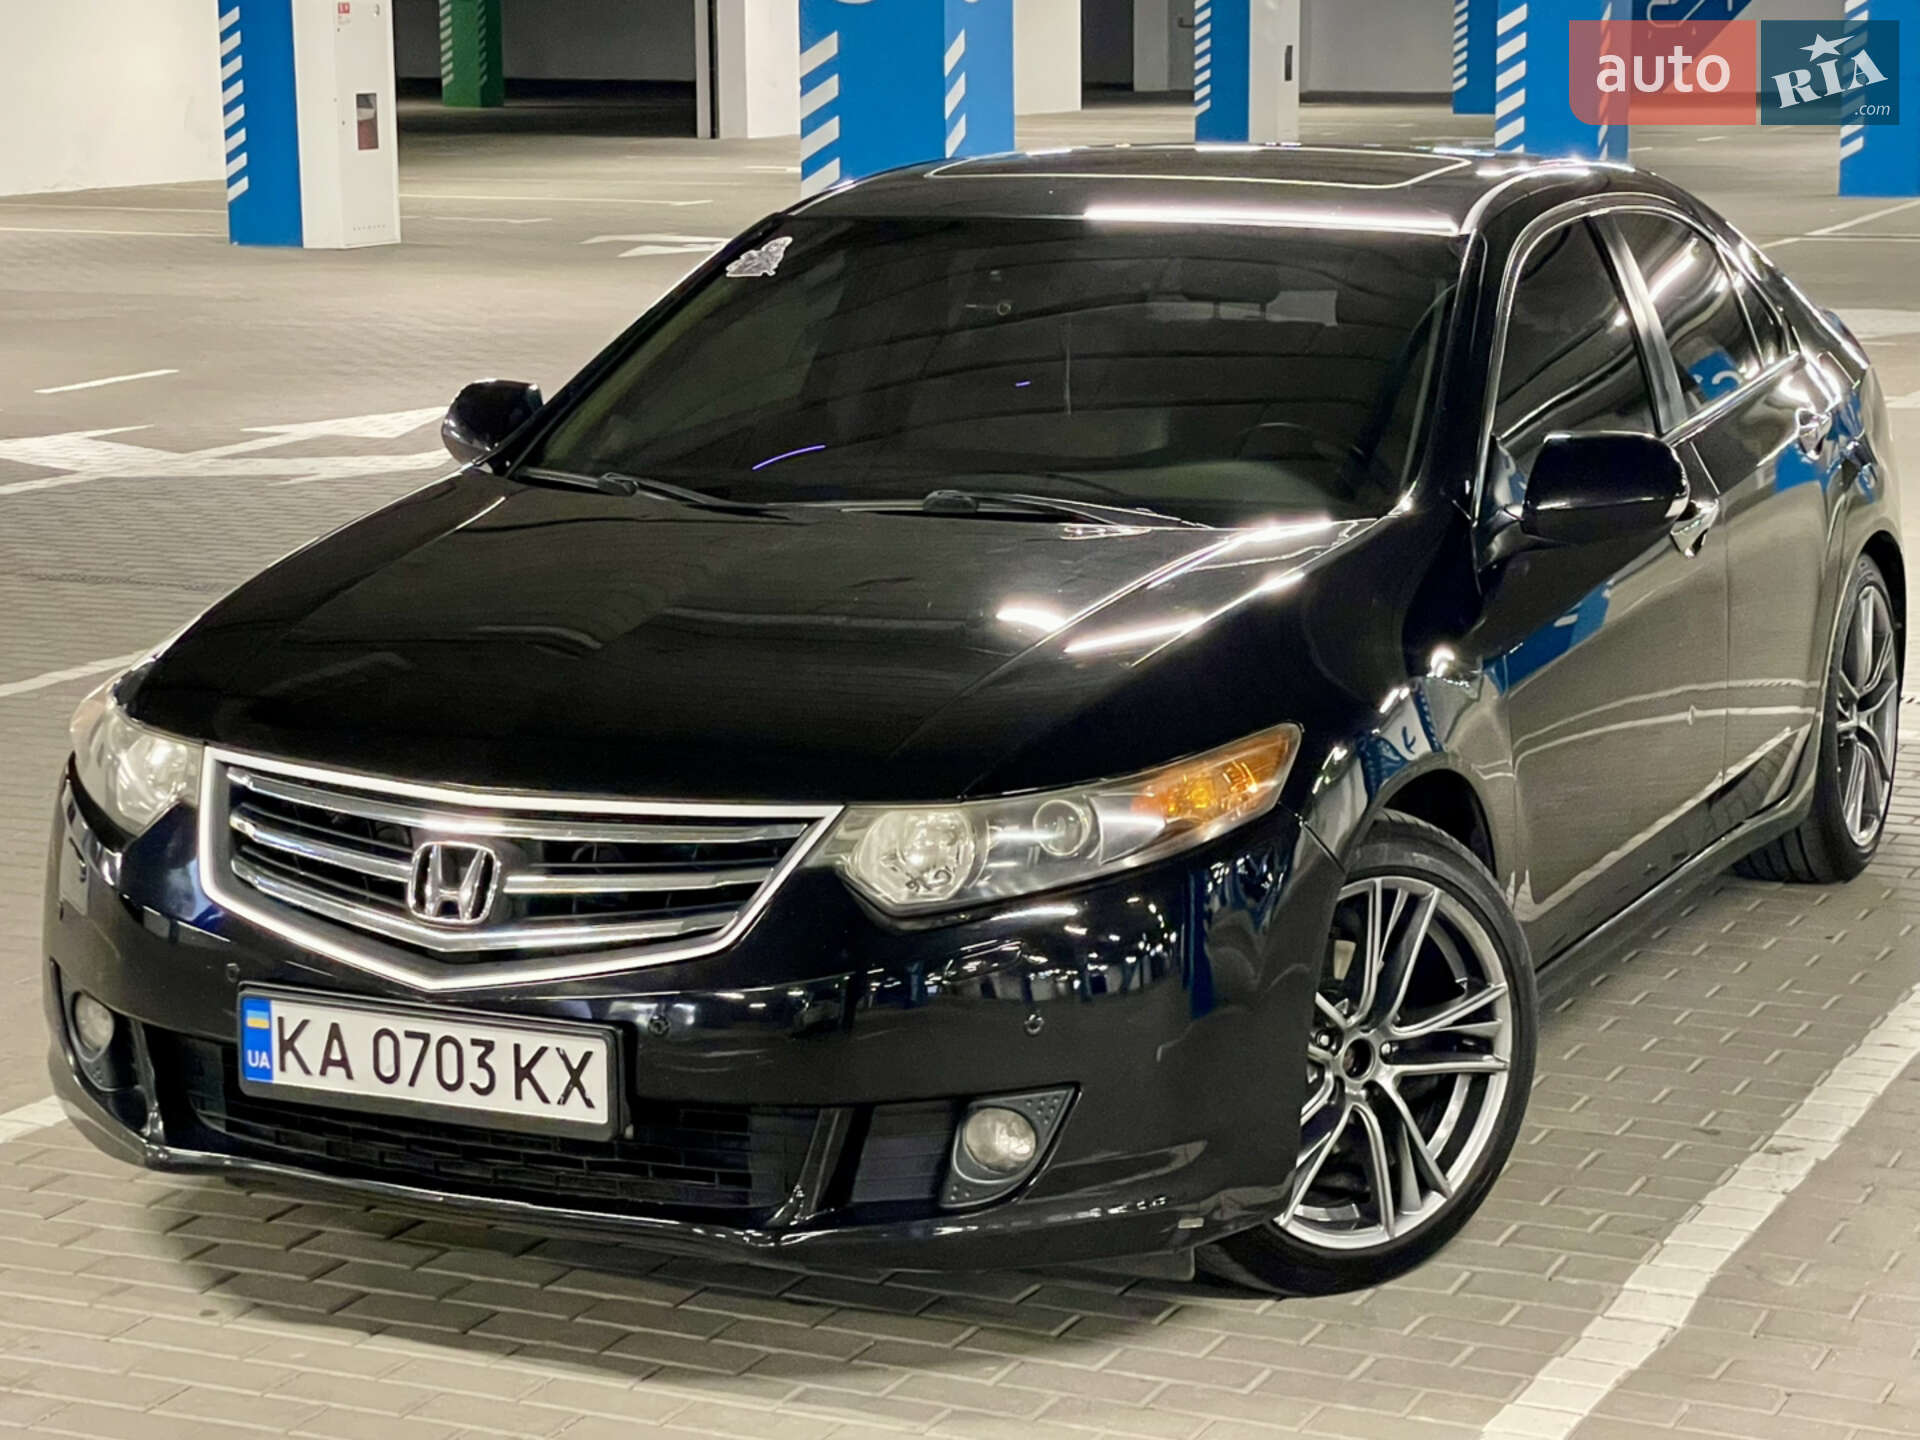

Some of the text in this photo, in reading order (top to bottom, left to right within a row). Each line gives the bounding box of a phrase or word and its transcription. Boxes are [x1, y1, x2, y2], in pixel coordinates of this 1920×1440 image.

[247, 1049, 271, 1069] UA
[277, 1016, 595, 1110] KA 0703 KX
